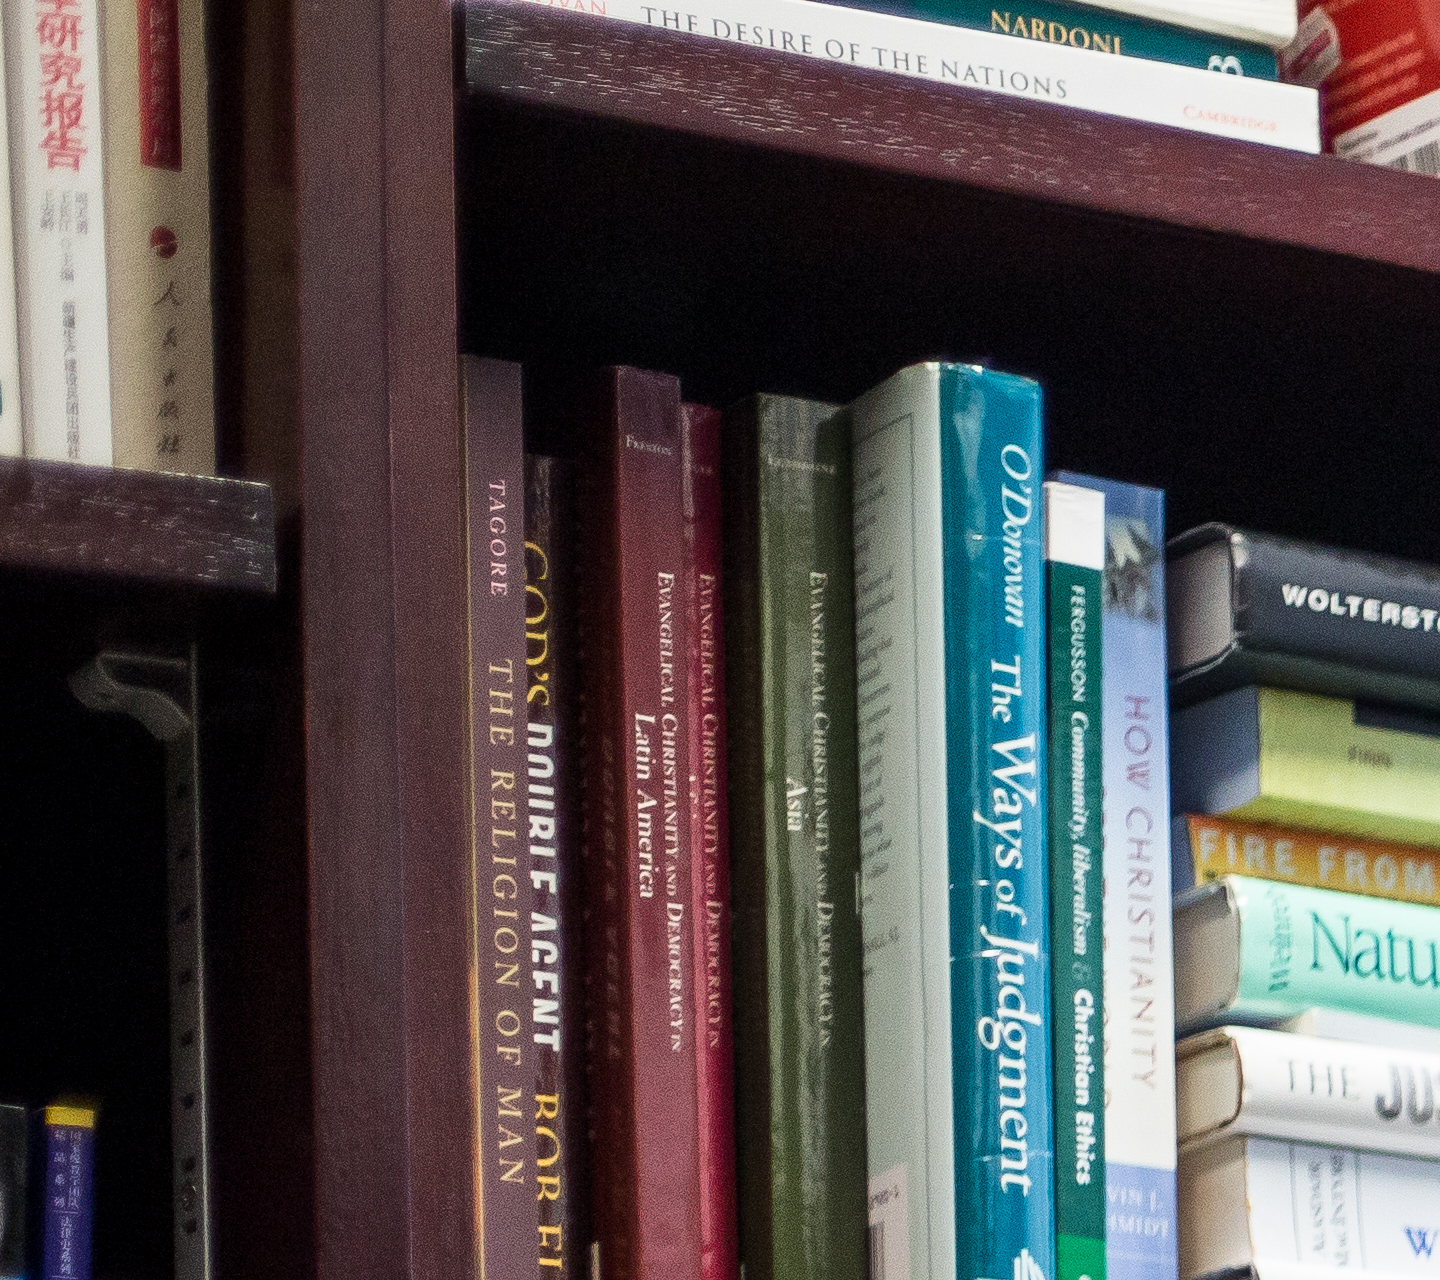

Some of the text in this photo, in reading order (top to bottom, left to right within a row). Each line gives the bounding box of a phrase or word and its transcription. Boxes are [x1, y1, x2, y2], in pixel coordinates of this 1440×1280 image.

[36, 0, 88, 172] 研究报告
[640, 6, 698, 31] THE
[711, 18, 814, 55] DESIRE
[825, 38, 863, 62] OF
[871, 46, 929, 75] THE
[941, 59, 1068, 99] NATIONS
[989, 10, 1122, 56] NARDONI
[1070, 584, 1086, 701] FERGUSSON
[488, 479, 524, 1185] TAGORE THE RELIGION OF MAN
[634, 713, 660, 898] Latin America
[657, 572, 685, 1053] EVANGELICAL CHRISTIANITY AND DEMOCRACY IN
[785, 776, 810, 832] Asia
[972, 443, 1043, 1197] O'Donovan The Ways of Judgment
[1068, 710, 1090, 840] Community,
[1071, 844, 1093, 955] liberalism
[1124, 694, 1158, 1091] HOW CHRISTIANITY
[1199, 827, 1296, 877] FIRE
[1317, 846, 1436, 897] FROM
[1073, 988, 1096, 1105] Christian
[1284, 1059, 1360, 1101] THE
[1075, 1110, 1096, 1186] Ethics
